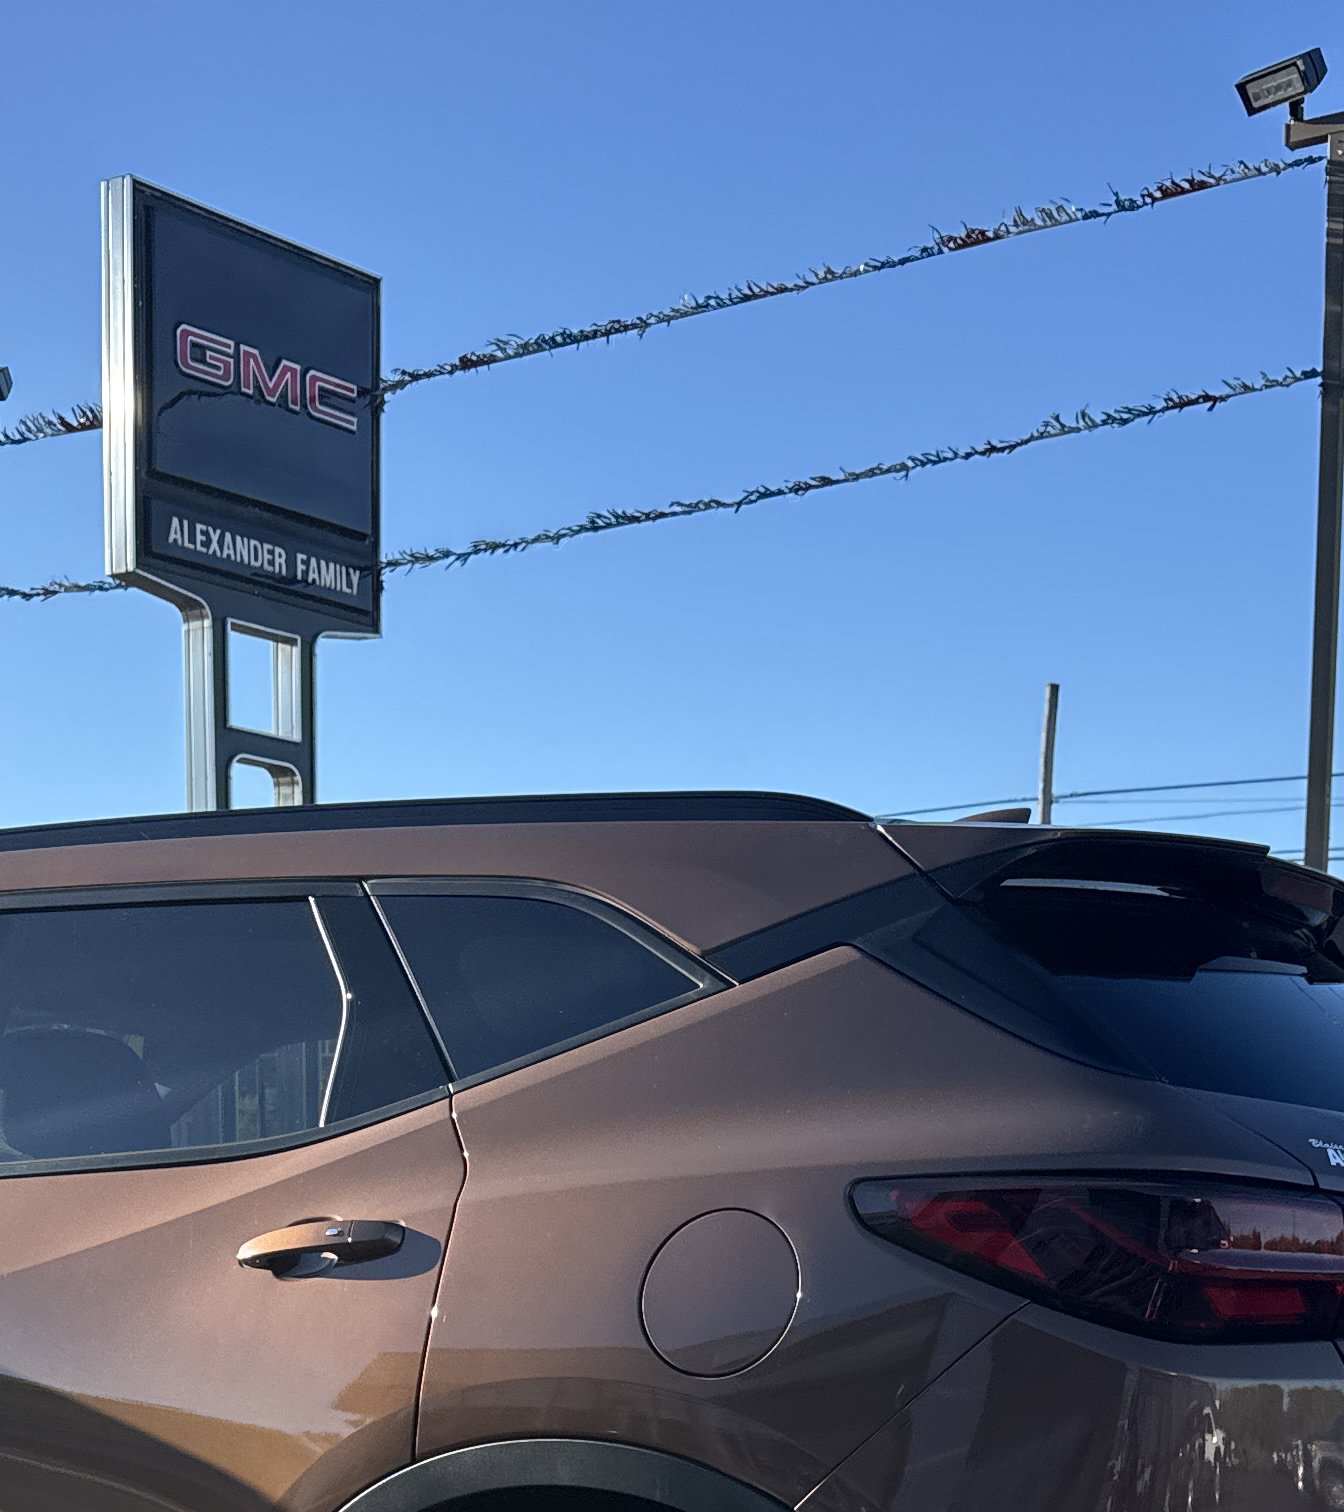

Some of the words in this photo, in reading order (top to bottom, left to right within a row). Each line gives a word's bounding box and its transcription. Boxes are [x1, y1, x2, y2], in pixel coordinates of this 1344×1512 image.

[176, 324, 357, 431] GMC
[168, 516, 286, 576] ALEXANDER
[296, 554, 360, 595] FAMILY
